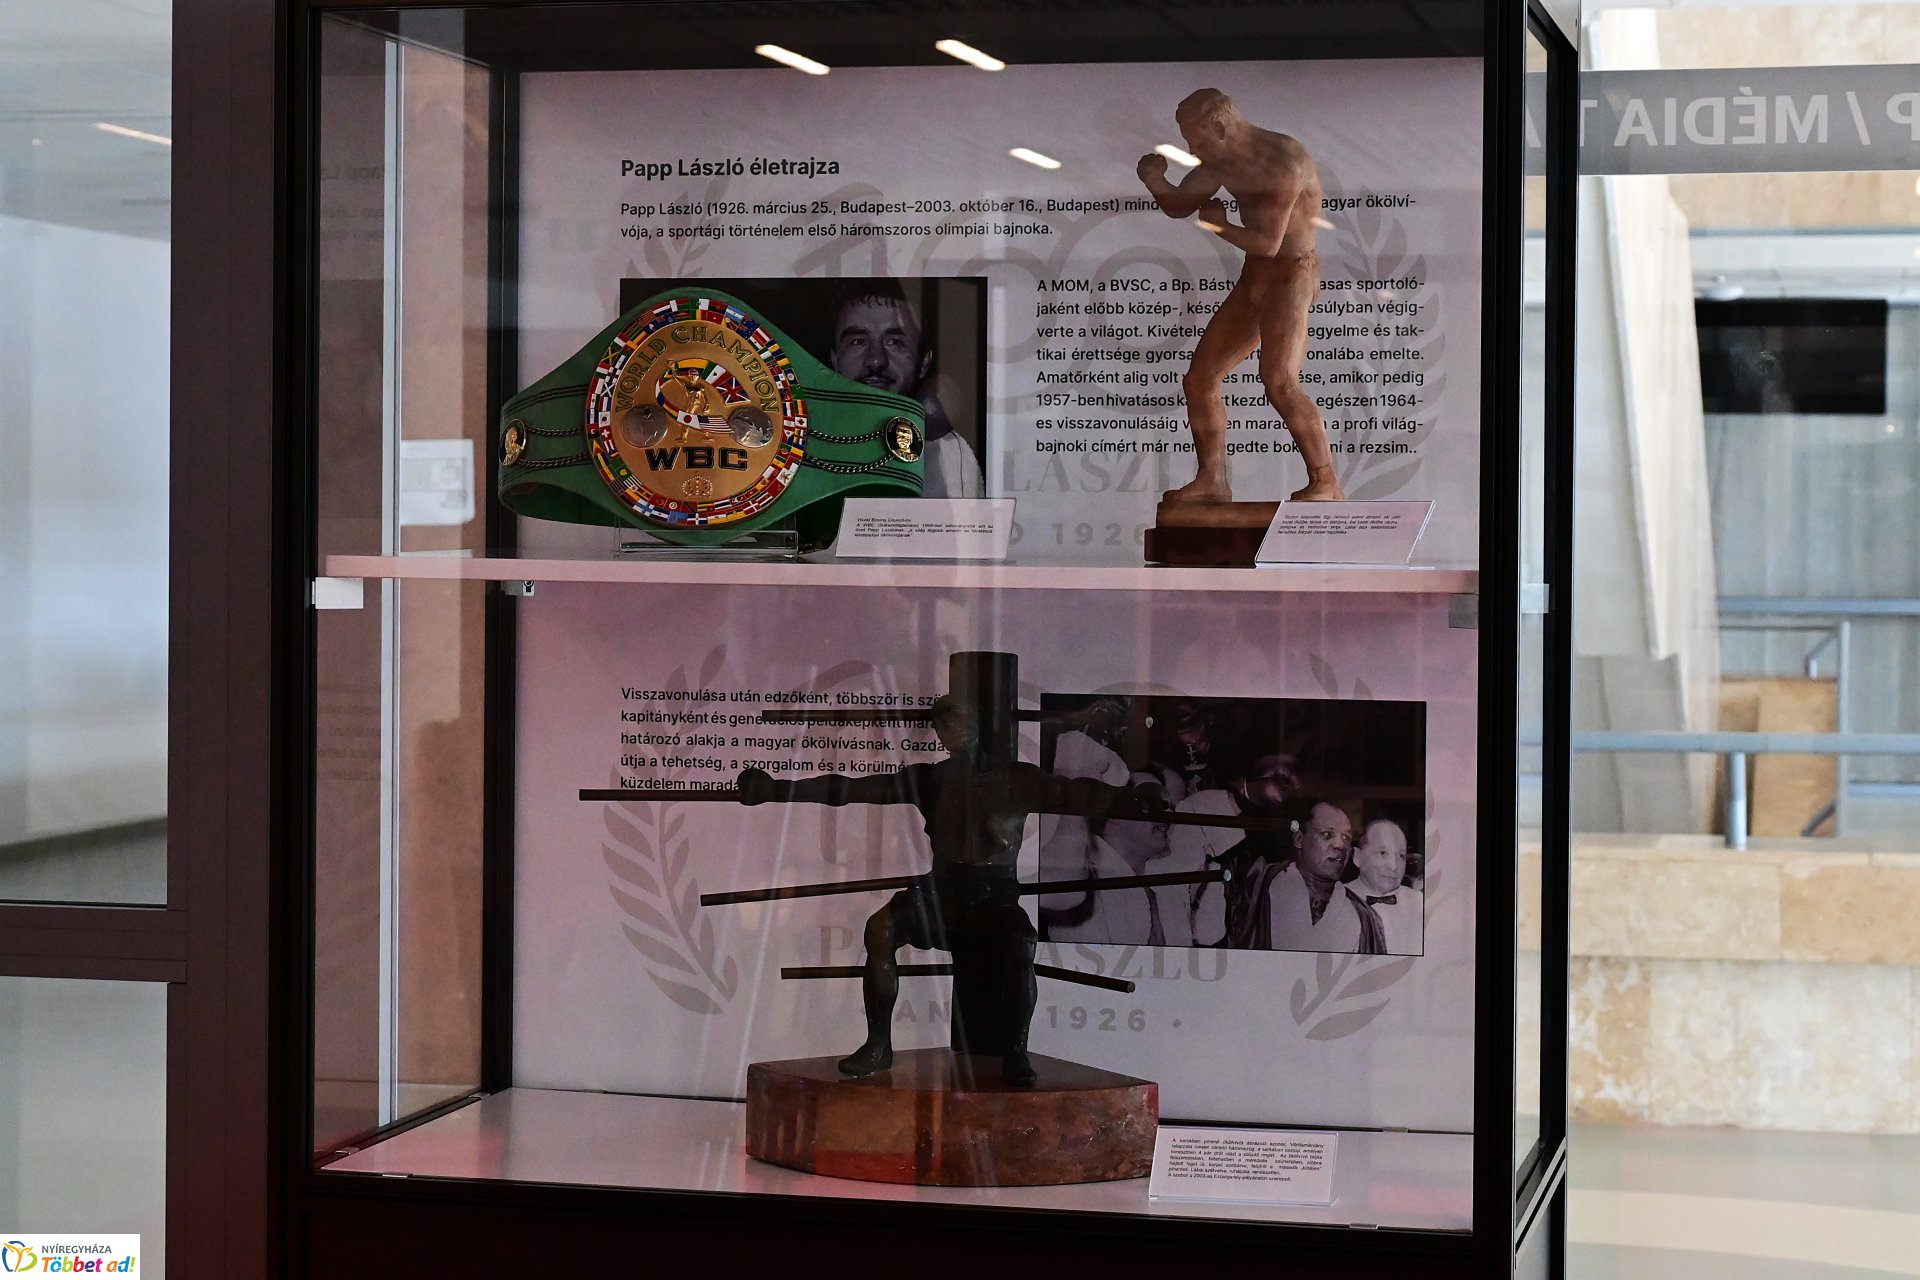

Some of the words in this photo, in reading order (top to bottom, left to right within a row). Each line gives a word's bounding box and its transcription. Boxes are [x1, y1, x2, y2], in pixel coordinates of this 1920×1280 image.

[622, 160, 672, 181] Papp
[679, 157, 744, 176] László
[750, 157, 839, 179] életrajza
[621, 203, 655, 218] Papp
[660, 202, 702, 215] László
[707, 202, 748, 216] (1926.
[753, 201, 807, 214] március
[811, 201, 835, 215] 25.,
[841, 200, 955, 216] Budapest–2003.
[960, 200, 1015, 212] október
[1019, 199, 1042, 214] 16.,
[1047, 198, 1119, 214] Budapest)
[1322, 198, 1362, 211] agyar
[1366, 194, 1416, 207] ökölví-
[621, 225, 652, 240] vója,
[656, 228, 663, 237] a
[669, 224, 724, 240] sportági
[729, 224, 803, 236] történelem
[808, 224, 836, 236] első
[841, 223, 931, 236] háromszoros
[935, 223, 988, 238] olimpiai
[994, 222, 1052, 237] bajnoka.
[1037, 280, 1047, 291] A
[1052, 279, 1093, 294] MOM,
[1098, 282, 1105, 291] a
[1111, 279, 1154, 294] BVSC,
[1159, 282, 1167, 291] a
[1172, 279, 1194, 294] Bp.
[1320, 280, 1351, 290] asas
[1357, 276, 1424, 292] sportoló-
[1036, 302, 1080, 317] jaként
[1084, 302, 1124, 314] előbb
[1129, 301, 1182, 317] közép-,
[1187, 301, 1222, 314] késő
[1377, 300, 1424, 316] végig-
[1037, 326, 1073, 337] verte
[1078, 328, 1086, 337] a
[1091, 324, 1142, 340] világot.
[1148, 324, 1205, 337] Kivétele
[1308, 324, 1368, 340] egyelme
[1374, 323, 1390, 336] és
[1395, 324, 1424, 336] tak-
[1036, 348, 1065, 360] tikai
[1072, 347, 1140, 363] érettsége
[1146, 351, 1193, 364] gyorsa
[1307, 347, 1364, 360] onalába
[1370, 347, 1424, 360] emelte.
[615, 338, 667, 413] WORLD
[671, 326, 780, 413] CHAMPION
[1037, 370, 1119, 383] Amatőrként
[1124, 371, 1148, 386] alig
[1152, 371, 1178, 383] volt
[1330, 371, 1379, 383] amikor
[1383, 371, 1423, 386] pedig
[1036, 394, 1104, 406] 1957-ben
[1106, 393, 1175, 406] hivatásos
[1316, 393, 1377, 409] egészen
[1380, 394, 1423, 406] 1964-
[1036, 420, 1052, 429] es
[1057, 416, 1177, 432] visszavonulásáig
[1332, 420, 1339, 429] a
[1344, 417, 1377, 433] profi
[1382, 417, 1423, 433] világ-
[1036, 439, 1087, 454] bajnoki
[1092, 439, 1137, 452] címért
[1142, 439, 1169, 452] már
[1347, 444, 1355, 453] a
[1360, 441, 1416, 453] rezsim..
[645, 446, 748, 471] WBC
[621, 688, 726, 701] Visszavonulása
[731, 690, 760, 702] után
[765, 691, 831, 706] edzőként,
[836, 692, 898, 705] többször
[901, 693, 915, 705] is
[621, 710, 708, 725] kapitányként
[711, 711, 726, 724] és
[621, 732, 680, 745] határozó
[686, 734, 725, 749] alakja
[731, 738, 738, 746] a
[745, 738, 796, 750] magyar
[802, 736, 894, 750] ökölvívásnak.
[901, 739, 949, 755] Gazda
[621, 754, 645, 769] útja
[650, 758, 657, 767] a
[662, 756, 725, 771] tehetség,
[730, 760, 737, 769] a
[741, 759, 813, 774] szorgalom
[818, 759, 833, 771] és
[838, 763, 845, 771] a
[851, 760, 912, 773] körülmé
[620, 776, 686, 789] küzdelem
[690, 777, 742, 790] marada
[1046, 1005, 1147, 1032] 1926
